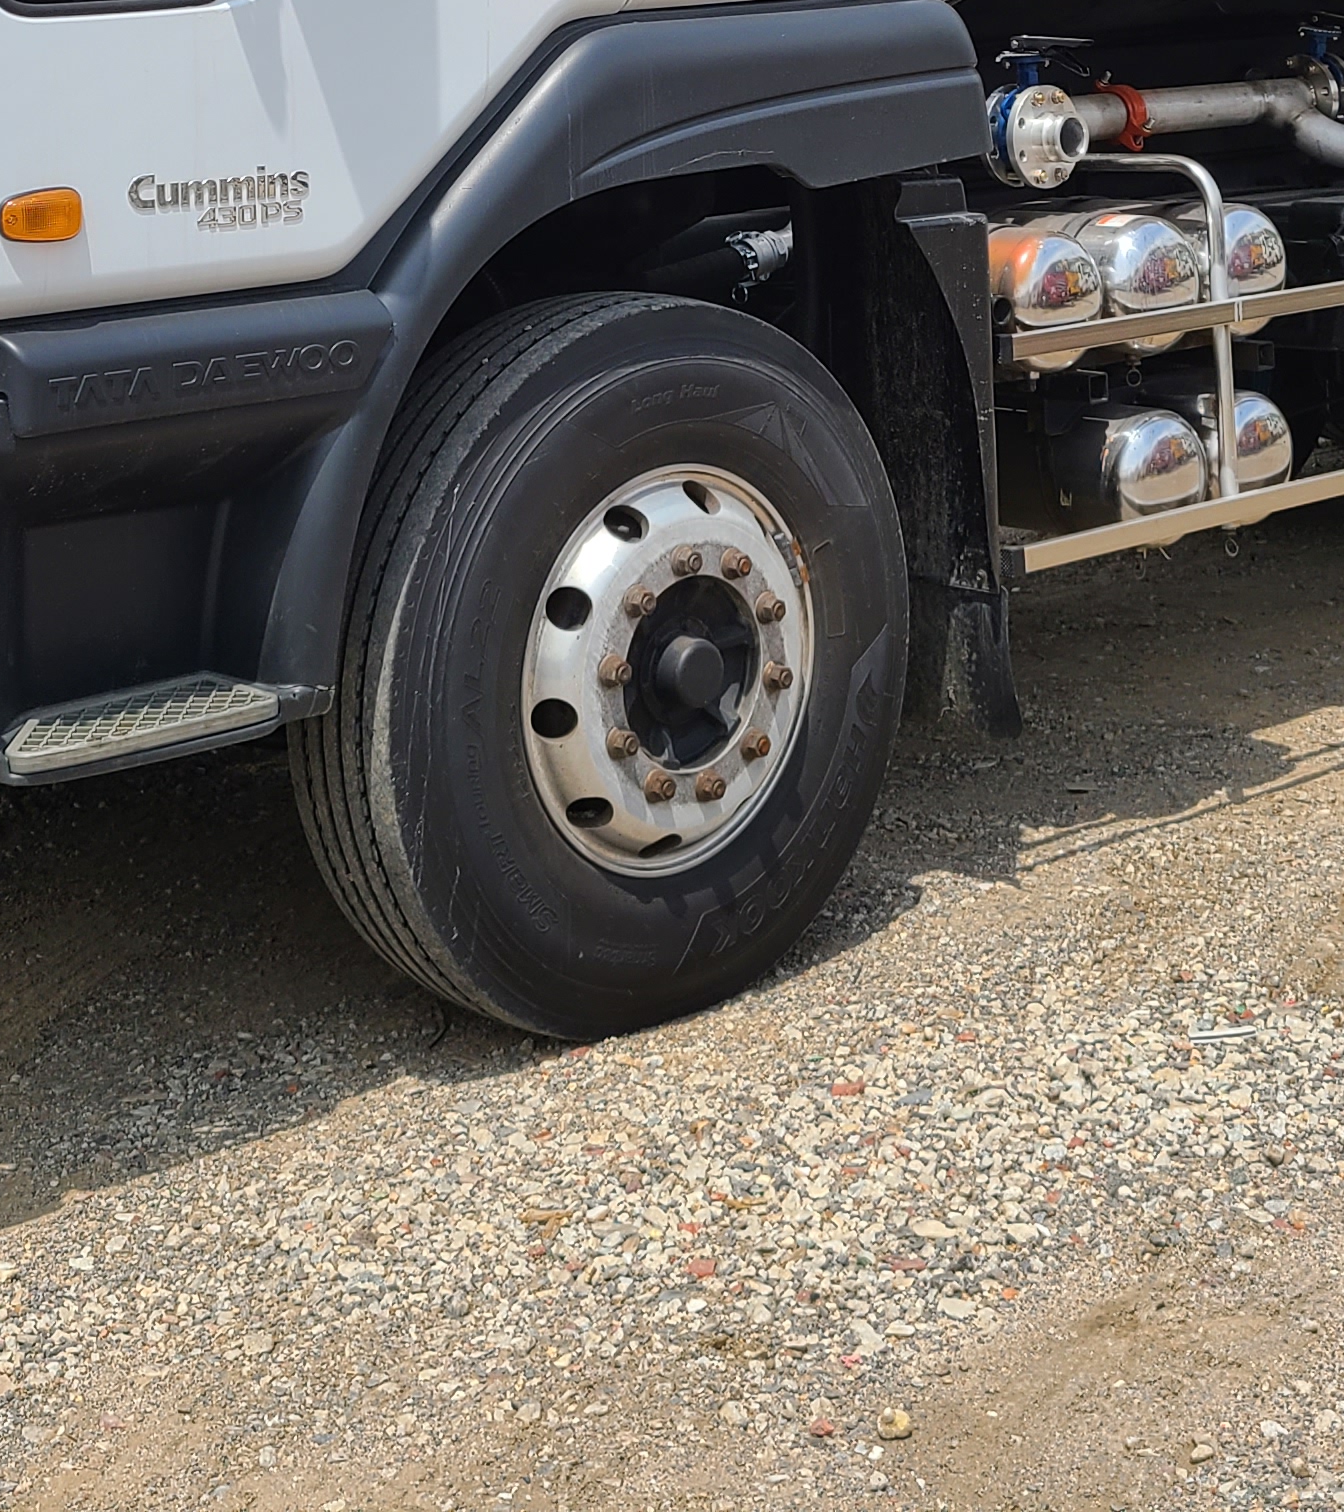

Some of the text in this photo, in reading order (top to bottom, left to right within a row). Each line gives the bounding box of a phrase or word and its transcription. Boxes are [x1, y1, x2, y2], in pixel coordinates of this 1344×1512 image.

[128, 165, 310, 215] Cummins
[48, 339, 360, 413] TATA DAEWOO
